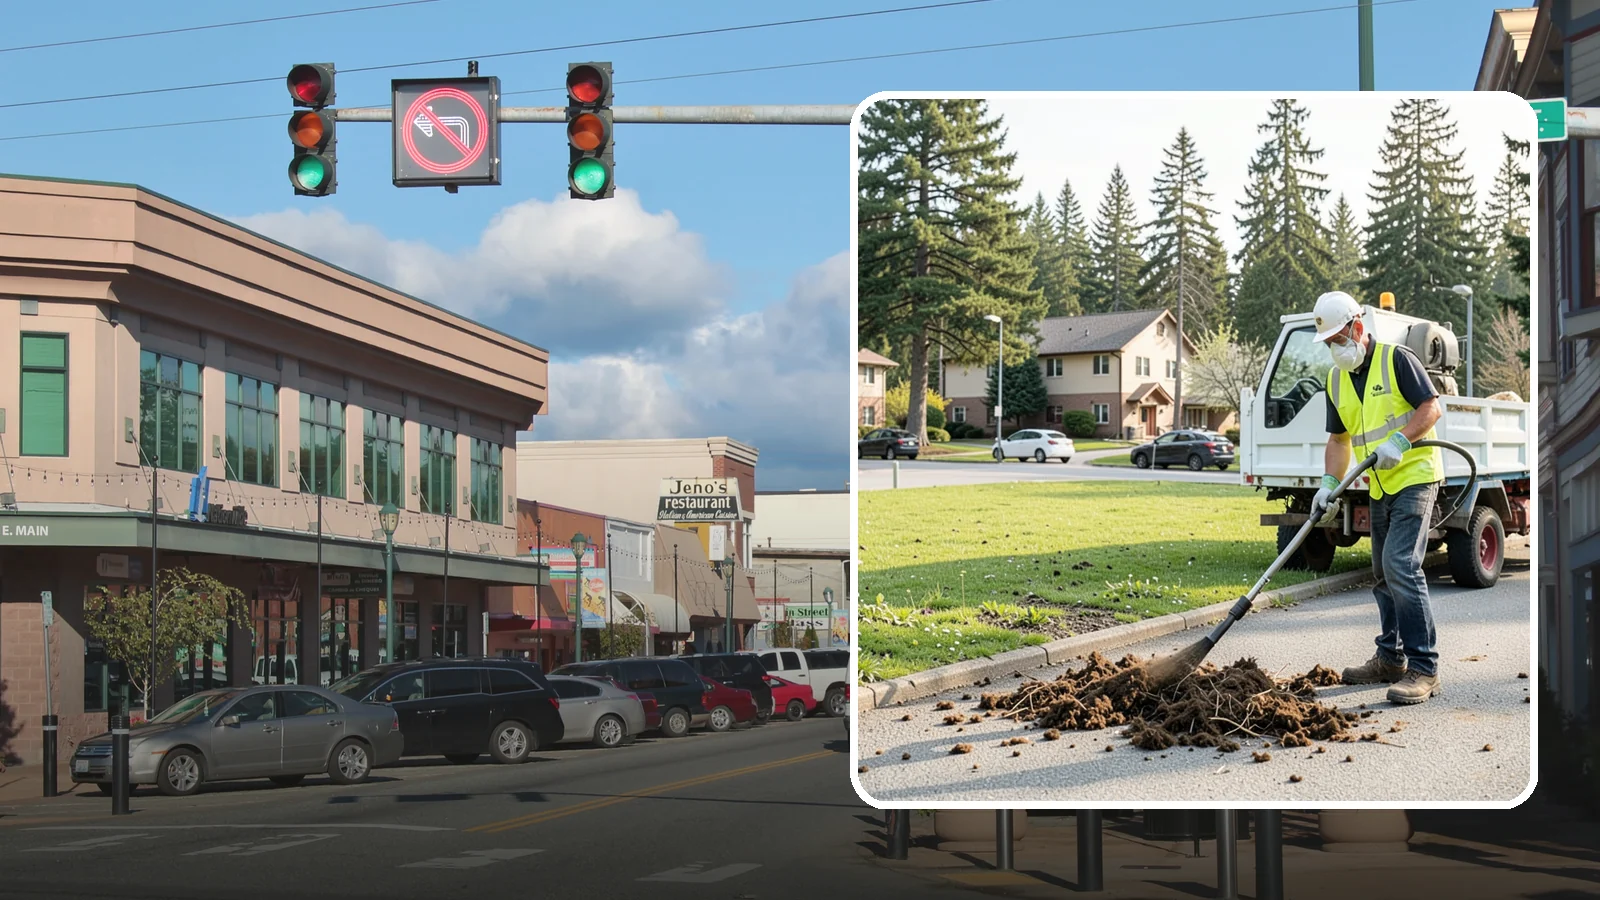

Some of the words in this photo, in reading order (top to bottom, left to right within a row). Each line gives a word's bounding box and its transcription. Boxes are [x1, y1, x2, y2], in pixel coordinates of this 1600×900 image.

[670, 480, 727, 494] Jeno's
[665, 496, 731, 509] restaurant
[658, 510, 681, 519] Italian
[686, 510, 714, 519] American
[714, 509, 738, 519] Cuisine
[2, 525, 13, 536] E.
[16, 525, 49, 536] MAIN
[798, 608, 828, 616] Street
